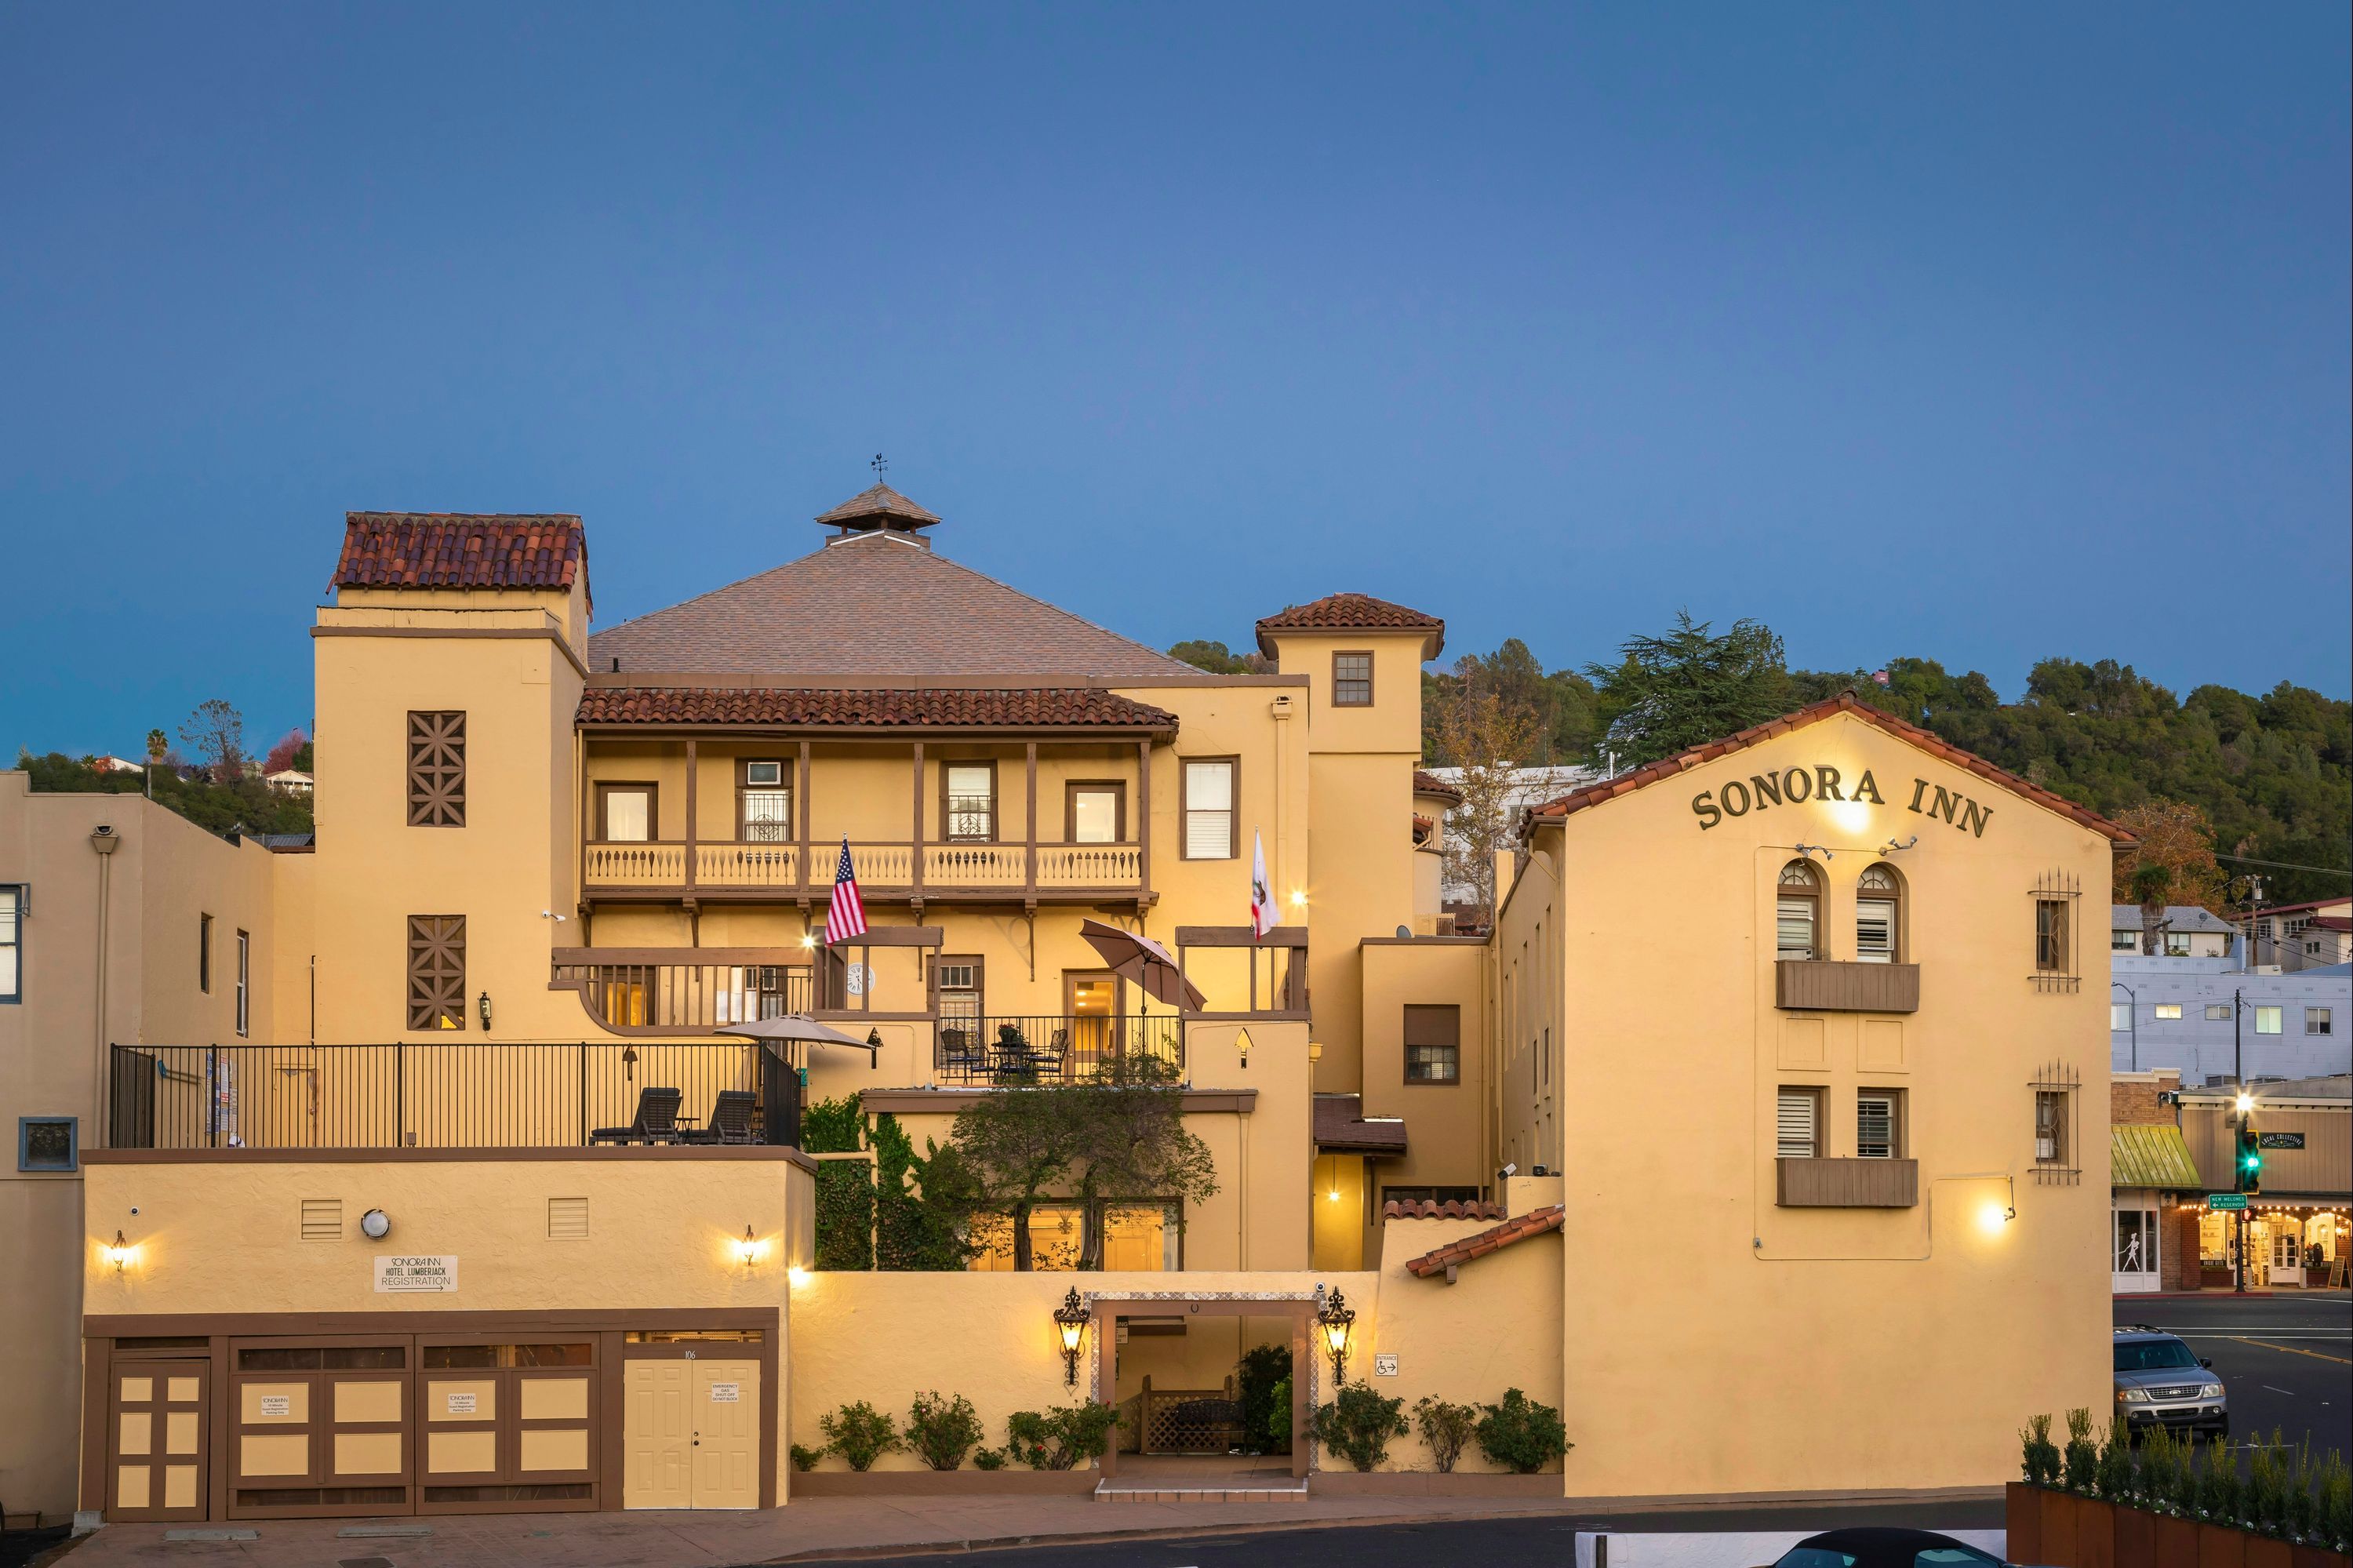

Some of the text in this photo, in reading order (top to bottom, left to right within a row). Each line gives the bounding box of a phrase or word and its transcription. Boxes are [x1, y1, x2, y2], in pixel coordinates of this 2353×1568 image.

[1692, 764, 1994, 838] SONORA INN
[2261, 1133, 2303, 1145] LOCAL COLLECTIVE
[391, 1257, 441, 1267] SONORA INN
[386, 1267, 446, 1276] HOTEL LUMBERJACK
[381, 1276, 450, 1286] REGISTRATION
[685, 1350, 696, 1359] 106
